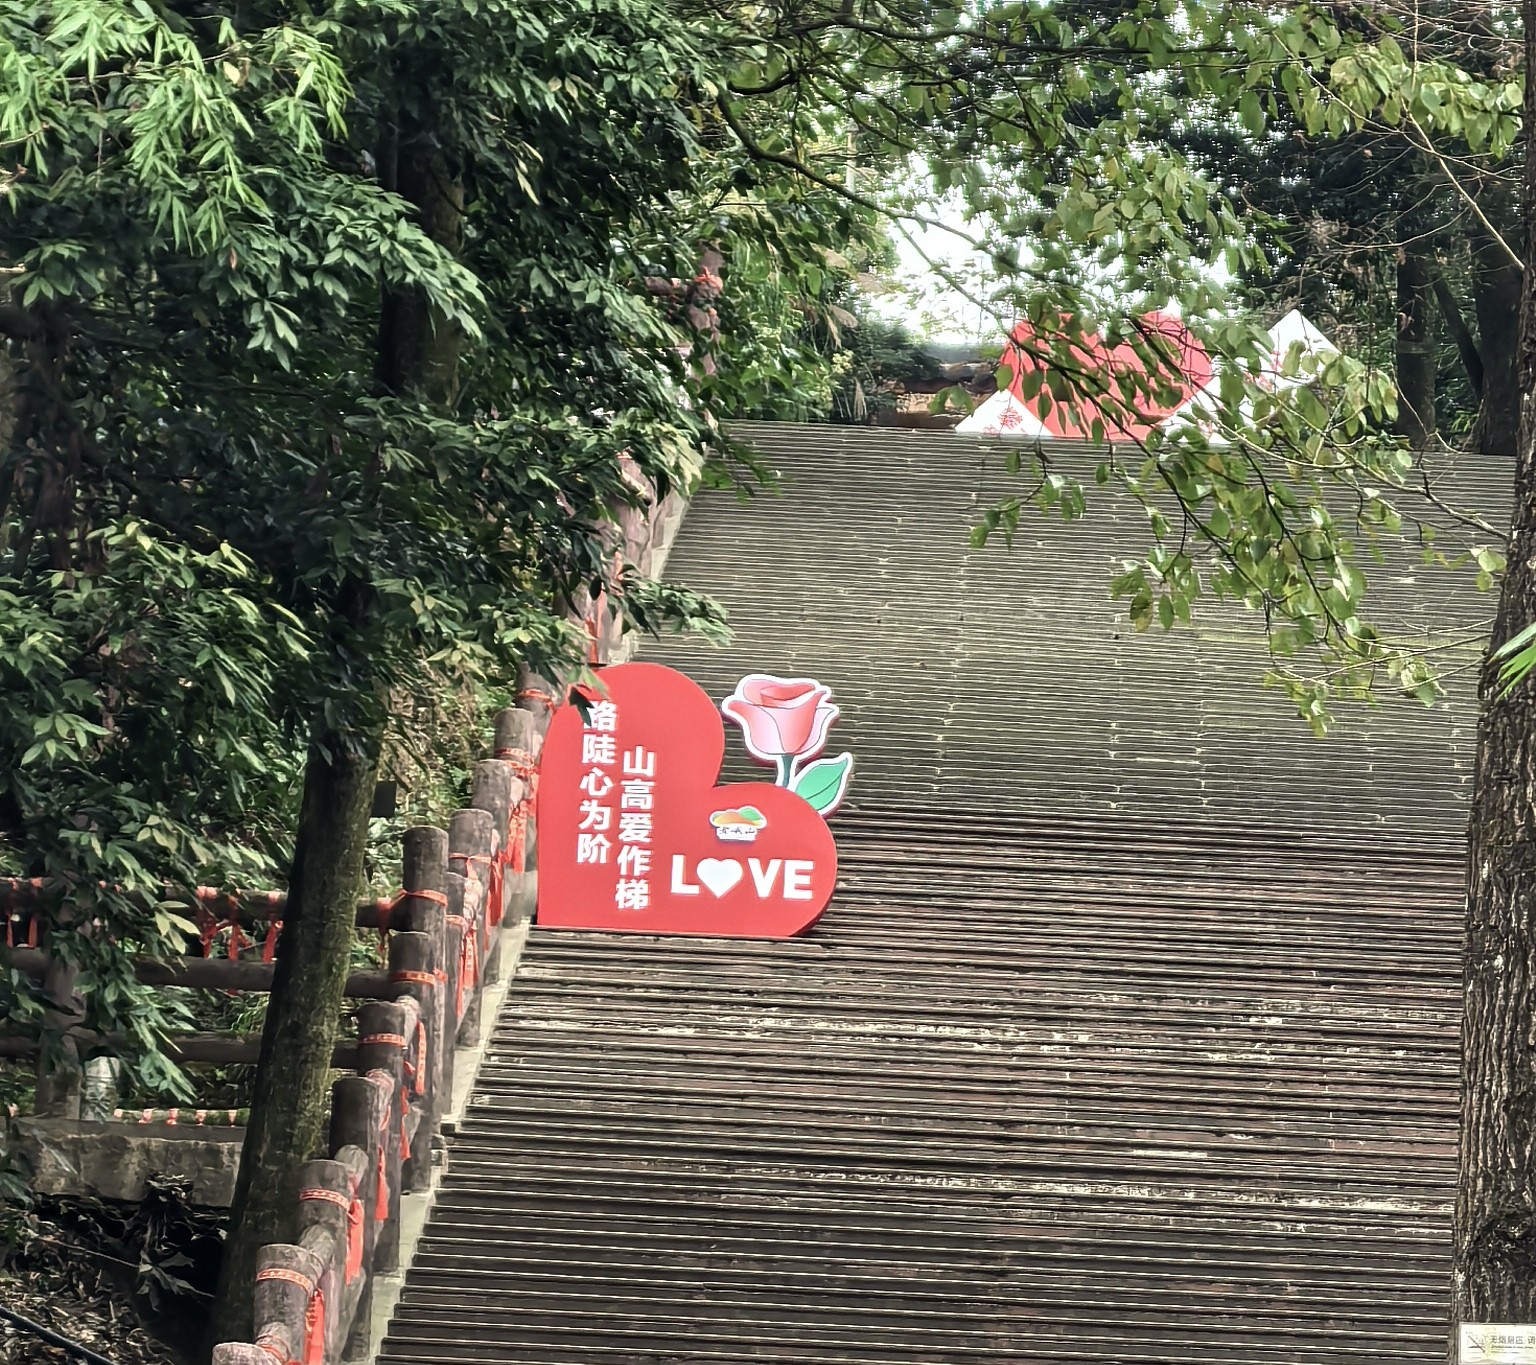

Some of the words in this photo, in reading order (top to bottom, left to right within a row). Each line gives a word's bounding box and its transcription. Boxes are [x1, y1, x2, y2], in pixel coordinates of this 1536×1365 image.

[577, 700, 617, 864] 路陡心为阶
[615, 745, 655, 910] 山高爱作梯
